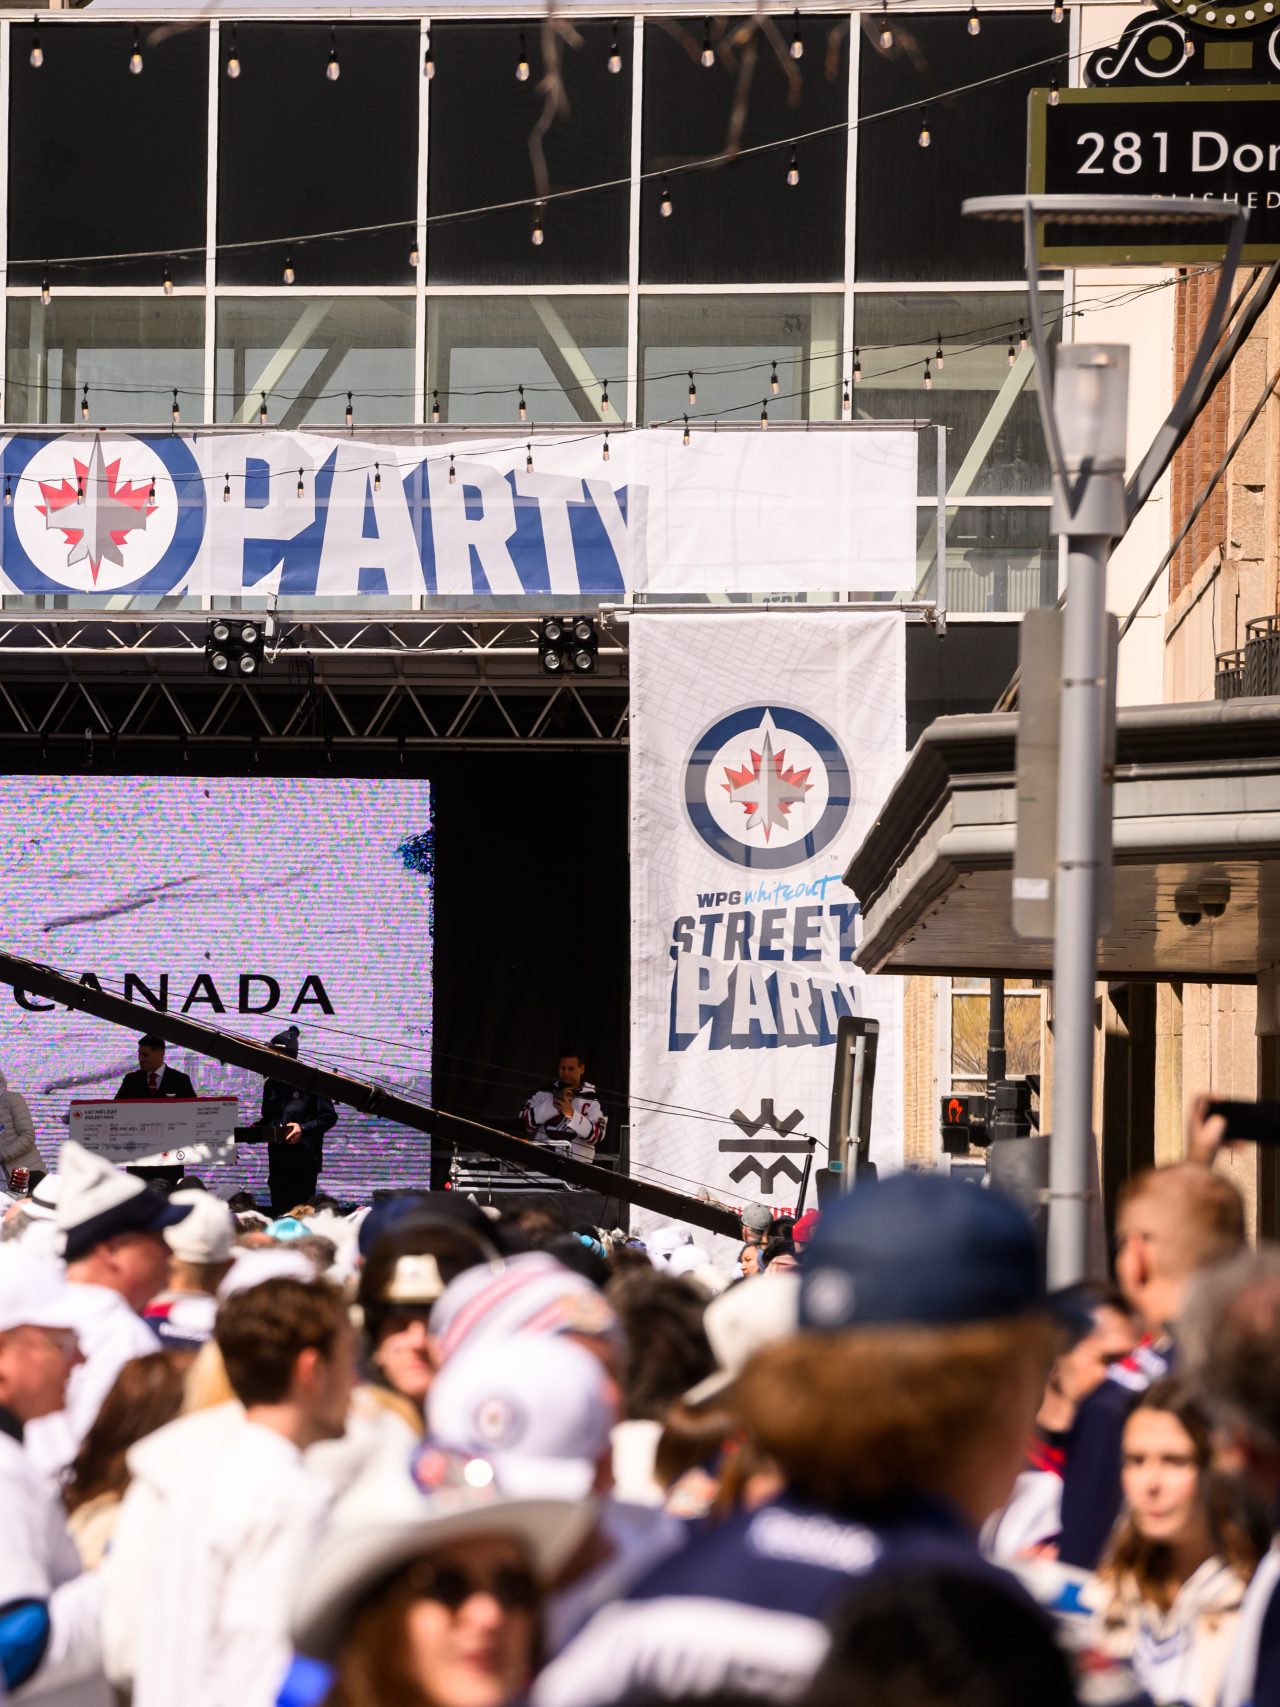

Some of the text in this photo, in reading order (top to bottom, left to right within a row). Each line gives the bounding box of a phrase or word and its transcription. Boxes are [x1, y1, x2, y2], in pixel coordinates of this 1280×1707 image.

[1076, 132, 1168, 174] 281
[202, 434, 648, 595] PARTY
[696, 874, 843, 908] WPG whiteout
[669, 902, 862, 962] STREET
[668, 951, 863, 1052] PARTY
[581, 1102, 591, 1117] C
